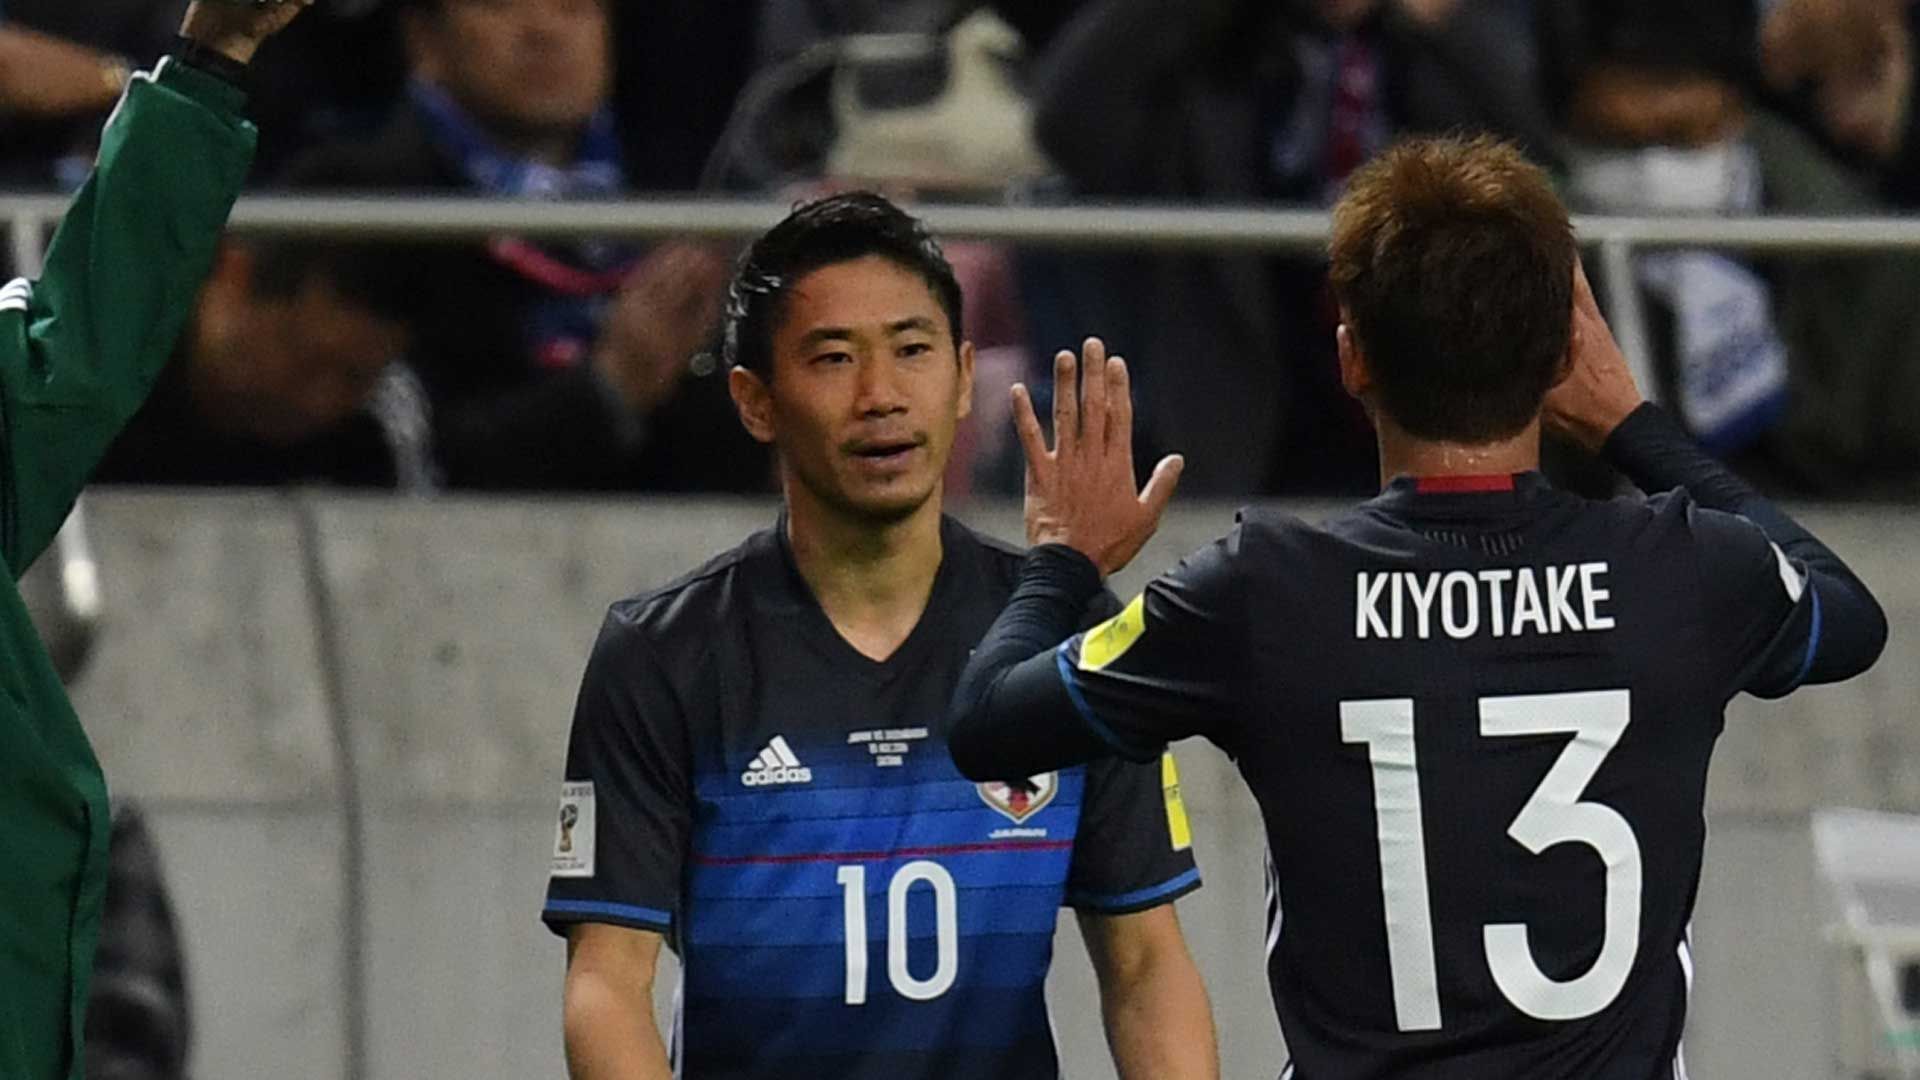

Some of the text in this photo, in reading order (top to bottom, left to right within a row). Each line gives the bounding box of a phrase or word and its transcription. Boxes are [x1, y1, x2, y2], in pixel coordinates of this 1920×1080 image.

[1356, 562, 1615, 639] KIYOTAKE
[741, 765, 812, 786] adidas
[1339, 689, 1643, 1031] 13
[836, 860, 958, 1004] 10
